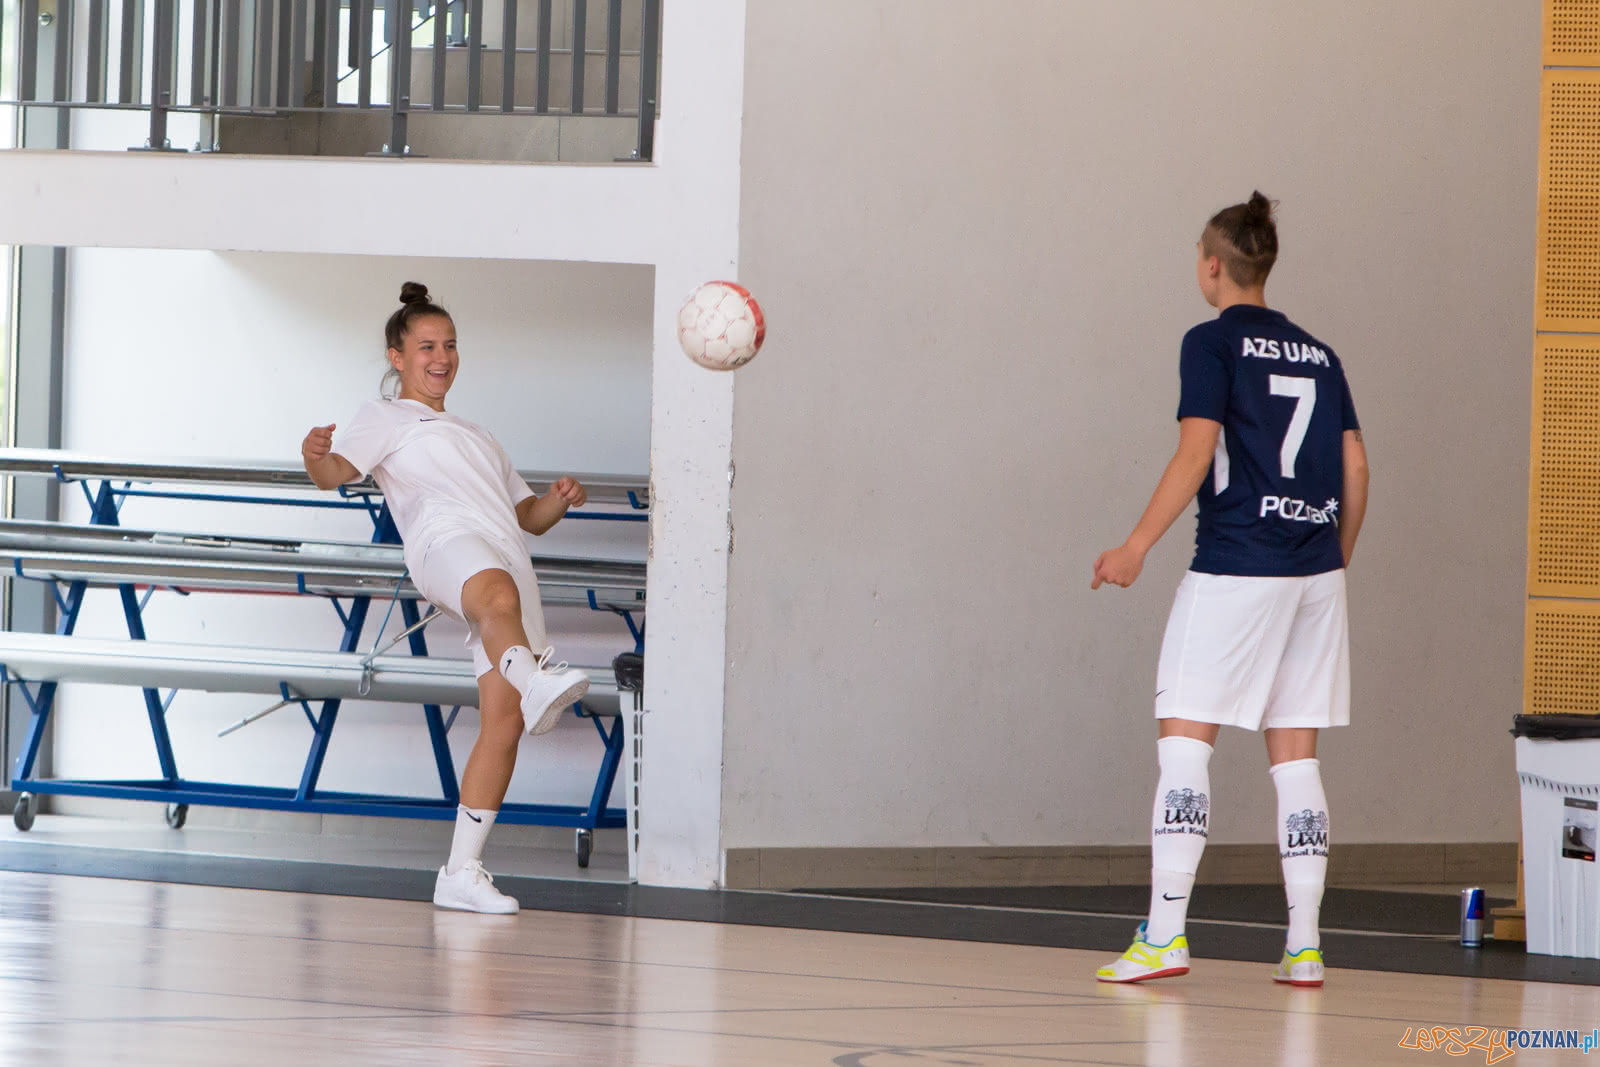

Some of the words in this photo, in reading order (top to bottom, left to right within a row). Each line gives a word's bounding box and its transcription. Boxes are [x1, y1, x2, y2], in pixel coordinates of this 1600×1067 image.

[1242, 337, 1281, 359] AZS
[1283, 341, 1330, 367] UAM
[1269, 374, 1316, 479] 7
[1165, 808, 1207, 827] UAM
[1288, 831, 1328, 848] UAM
